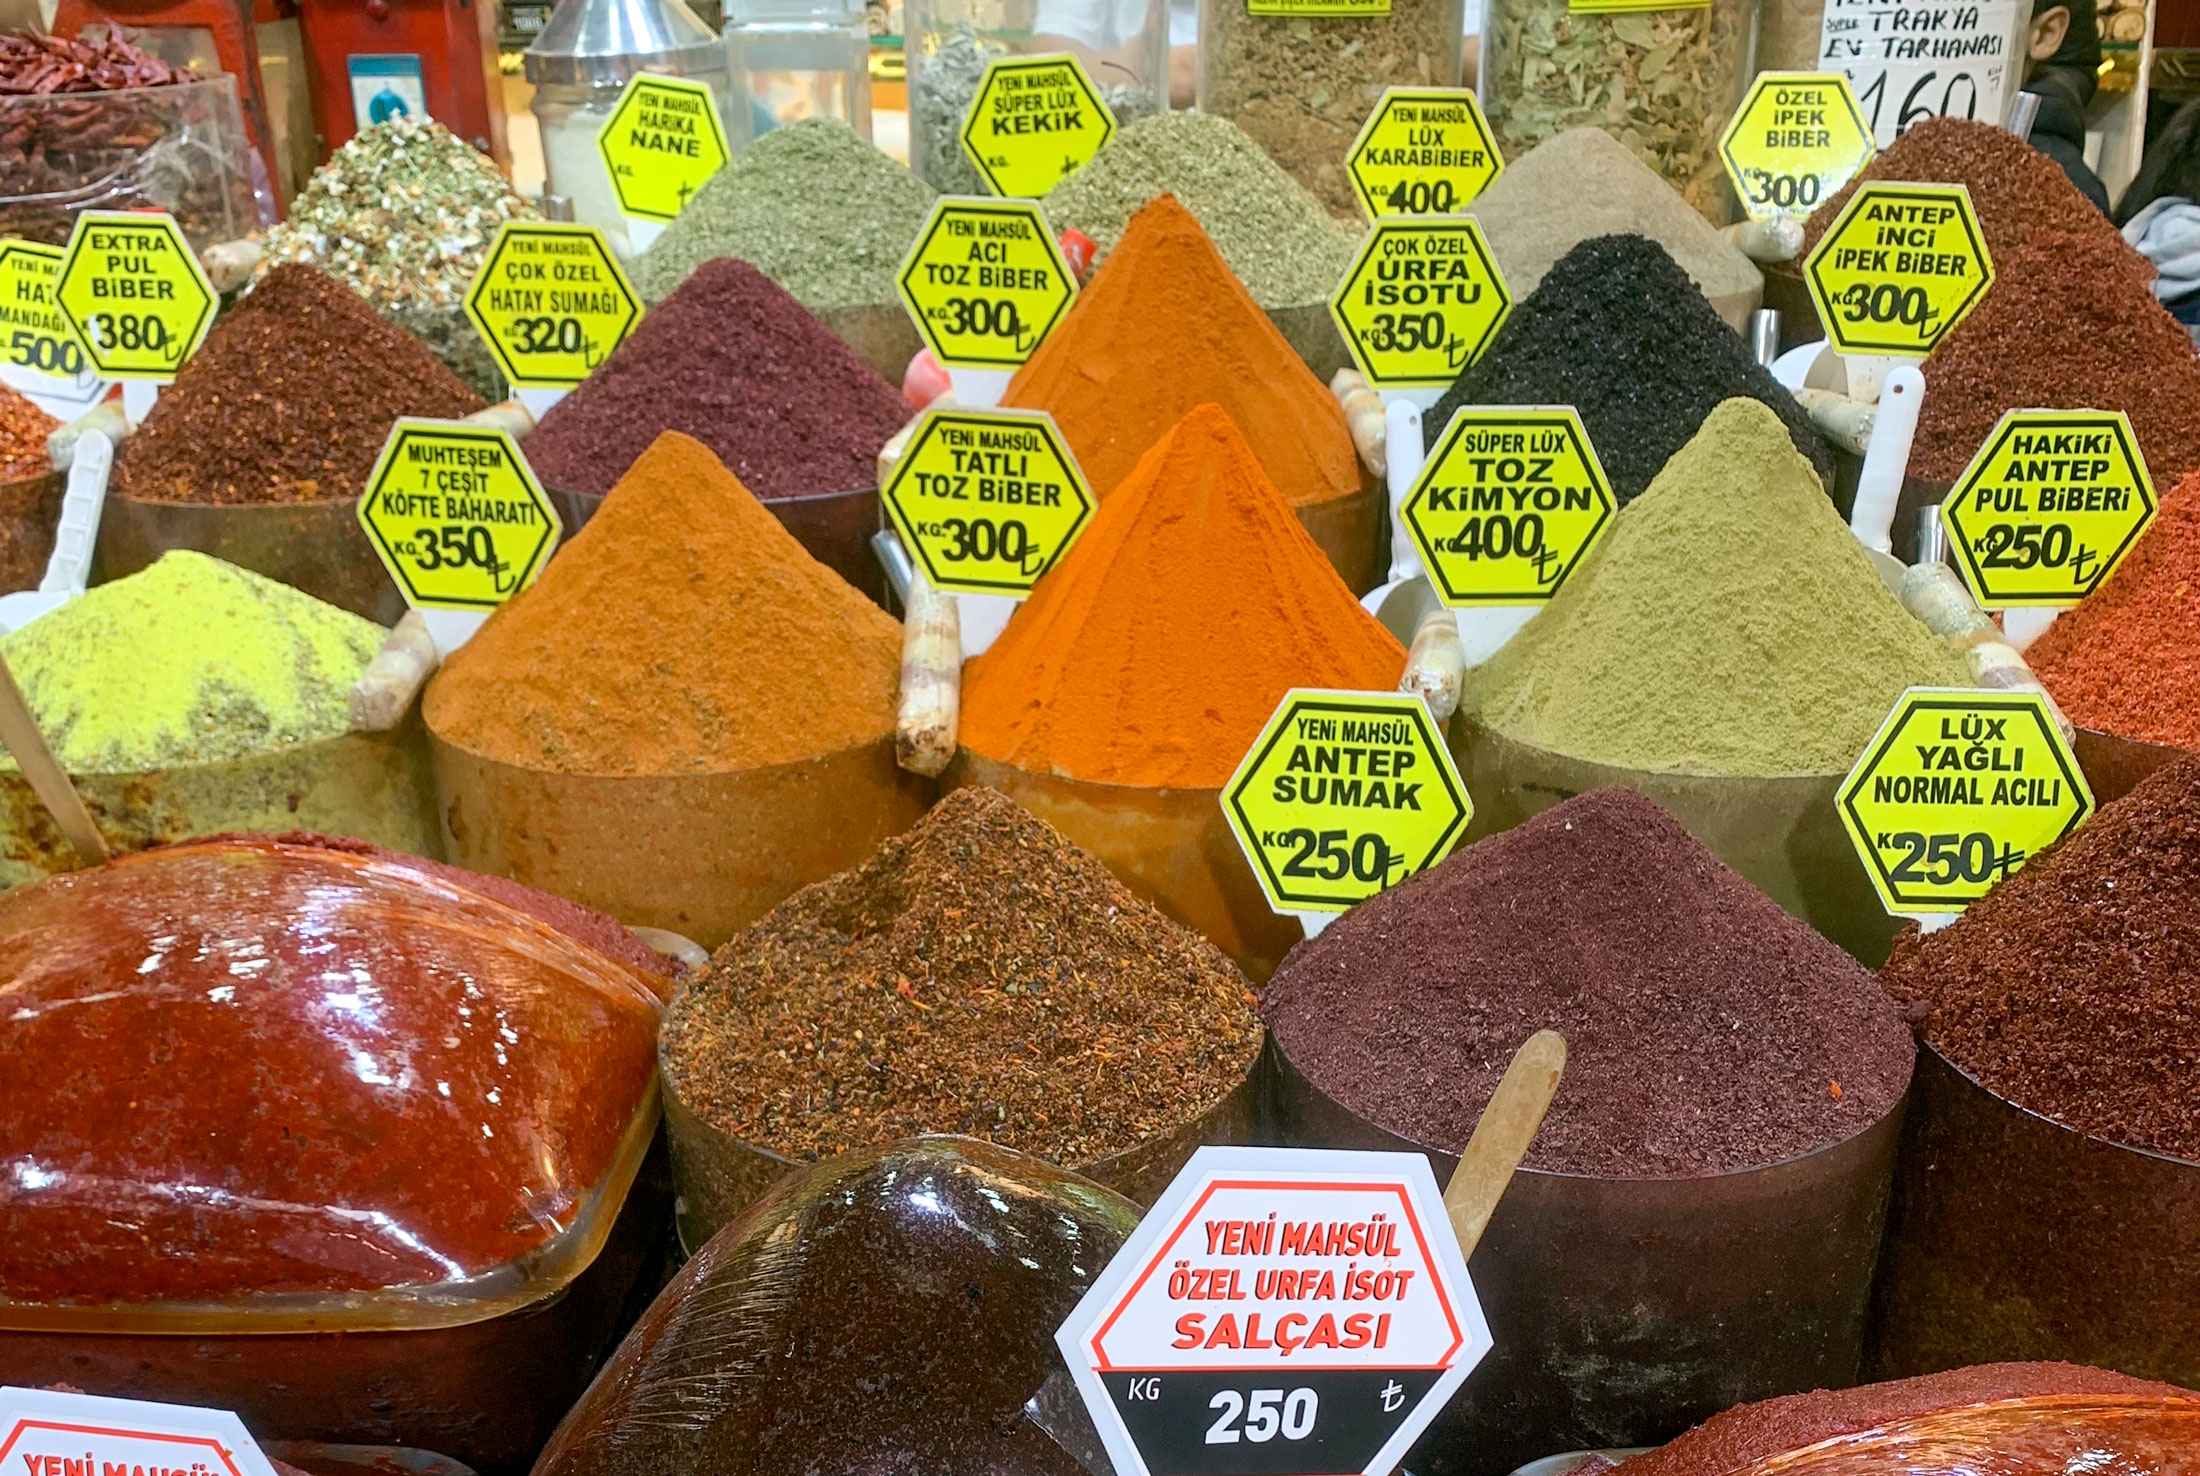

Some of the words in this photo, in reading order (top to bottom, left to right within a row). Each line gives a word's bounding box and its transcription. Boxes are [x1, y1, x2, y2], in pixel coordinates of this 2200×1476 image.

[1868, 6, 1979, 32] TRAKYA
[1824, 38, 1863, 58] EV
[1881, 34, 2003, 59] TARHANASI
[1048, 86, 1078, 110] LÜX
[1775, 88, 1828, 106] ÖZEL
[630, 129, 701, 158] NANE
[1408, 126, 1445, 147] LÜX
[1751, 171, 1820, 207] 300
[1865, 204, 1956, 225] ANTEP
[91, 234, 168, 251] EXTRA
[968, 241, 1007, 264] ACI
[1383, 238, 1419, 259] ÇOK
[1425, 234, 1469, 255] ÖZEL
[107, 256, 157, 274] PUL
[506, 262, 546, 284] ÇOK
[553, 258, 602, 282] ÖZEL
[925, 263, 971, 286] TOZ
[1377, 260, 1470, 281] URFA
[490, 288, 543, 312] HATAY
[549, 286, 619, 315] SUMAĞI
[1365, 280, 1482, 306] İSOTU
[1843, 283, 1928, 325] 300
[95, 313, 167, 351] 380
[944, 298, 1018, 337] 300
[1372, 311, 1445, 352] 350
[512, 317, 582, 354] 320
[10, 330, 84, 375] 500
[979, 431, 1043, 453] MAHSÜL
[1464, 429, 1525, 454] SÜPER
[1530, 429, 1566, 454] LÜX
[407, 443, 502, 471] MUHTEŞEM
[950, 449, 1028, 478] TATLI
[1468, 458, 1555, 484] TOZ
[2003, 460, 2110, 483] ANTEP
[419, 469, 430, 490] 7
[914, 473, 970, 501] TOZ
[381, 487, 441, 519] KÖFTE
[446, 496, 537, 526] BAHARATI
[1974, 487, 2029, 513] PUL
[413, 525, 496, 570] 350
[941, 518, 1028, 563] 300
[1452, 513, 1545, 562] 400
[1981, 523, 2073, 570] 250
[1341, 718, 1415, 746] MAHSÜL
[1940, 713, 2008, 741] LÜX
[1285, 744, 1417, 778] ANTEP
[1915, 741, 2024, 772] YAĞLI
[1272, 775, 1425, 812] SUMAK
[1873, 775, 1984, 806] NORMAL
[1990, 777, 2061, 807] ACILI
[1281, 827, 1388, 883] 250
[1889, 831, 1996, 886] 250
[1204, 1211, 1278, 1257] YENİ
[1278, 1212, 1402, 1258] MAHSÜL
[1167, 1259, 1247, 1301] ÖZEL
[1254, 1268, 1337, 1301] URFA
[1343, 1261, 1416, 1301] İSOT
[1170, 1311, 1393, 1357] SALÇASI
[1127, 1377, 1162, 1401] KG
[1204, 1387, 1320, 1446] 250
